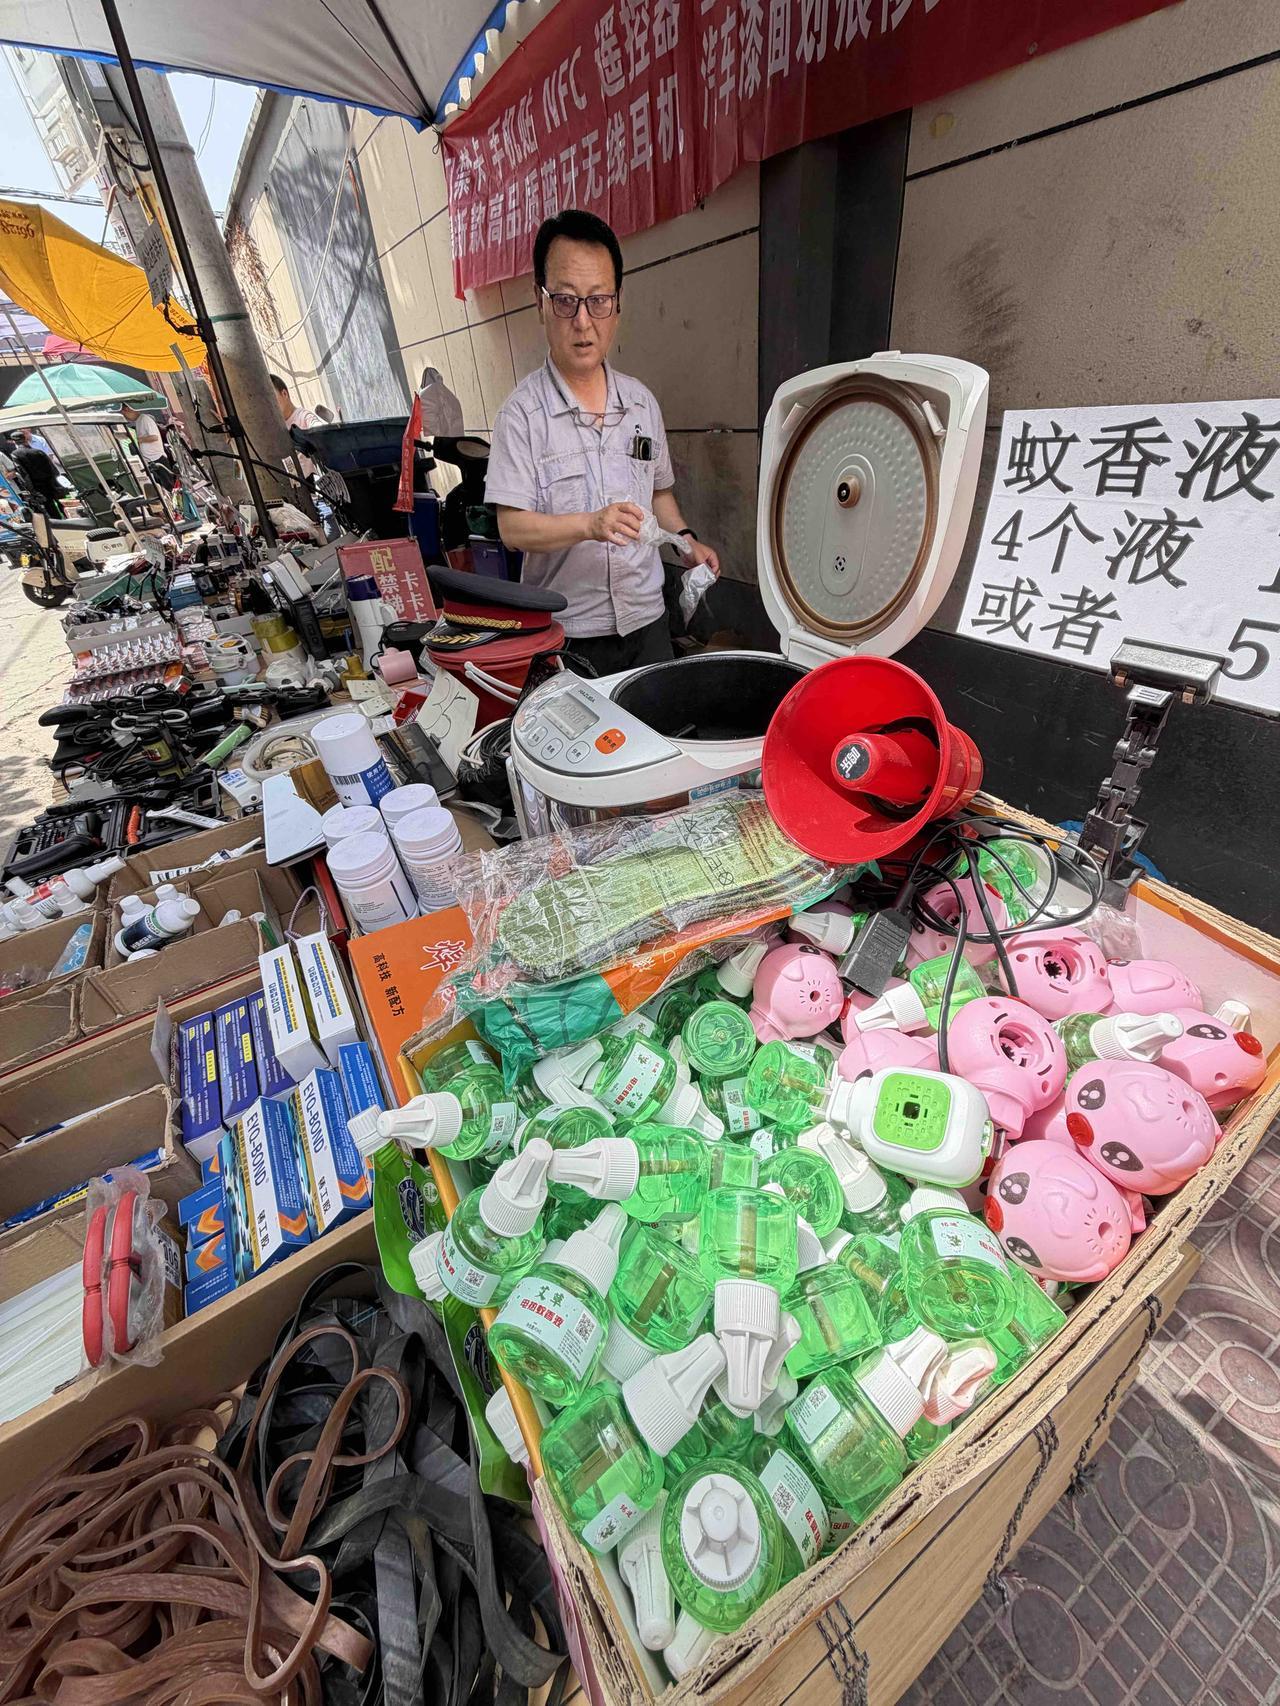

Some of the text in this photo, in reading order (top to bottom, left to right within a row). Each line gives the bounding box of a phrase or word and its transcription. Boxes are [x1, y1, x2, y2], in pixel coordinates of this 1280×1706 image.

[542, 45, 588, 133] NFC
[1003, 411, 1280, 503] 蚊香液
[368, 546, 396, 573] 配
[990, 501, 1204, 589] 4个液
[970, 576, 1122, 656] 或者
[372, 952, 406, 1017] 高科技 新配方
[247, 1111, 267, 1187] EYQ-BOND
[304, 1081, 325, 1153] EYQ-BOND
[519, 1297, 565, 1329] 电热蚊香液
[533, 1285, 566, 1309] 艾草
